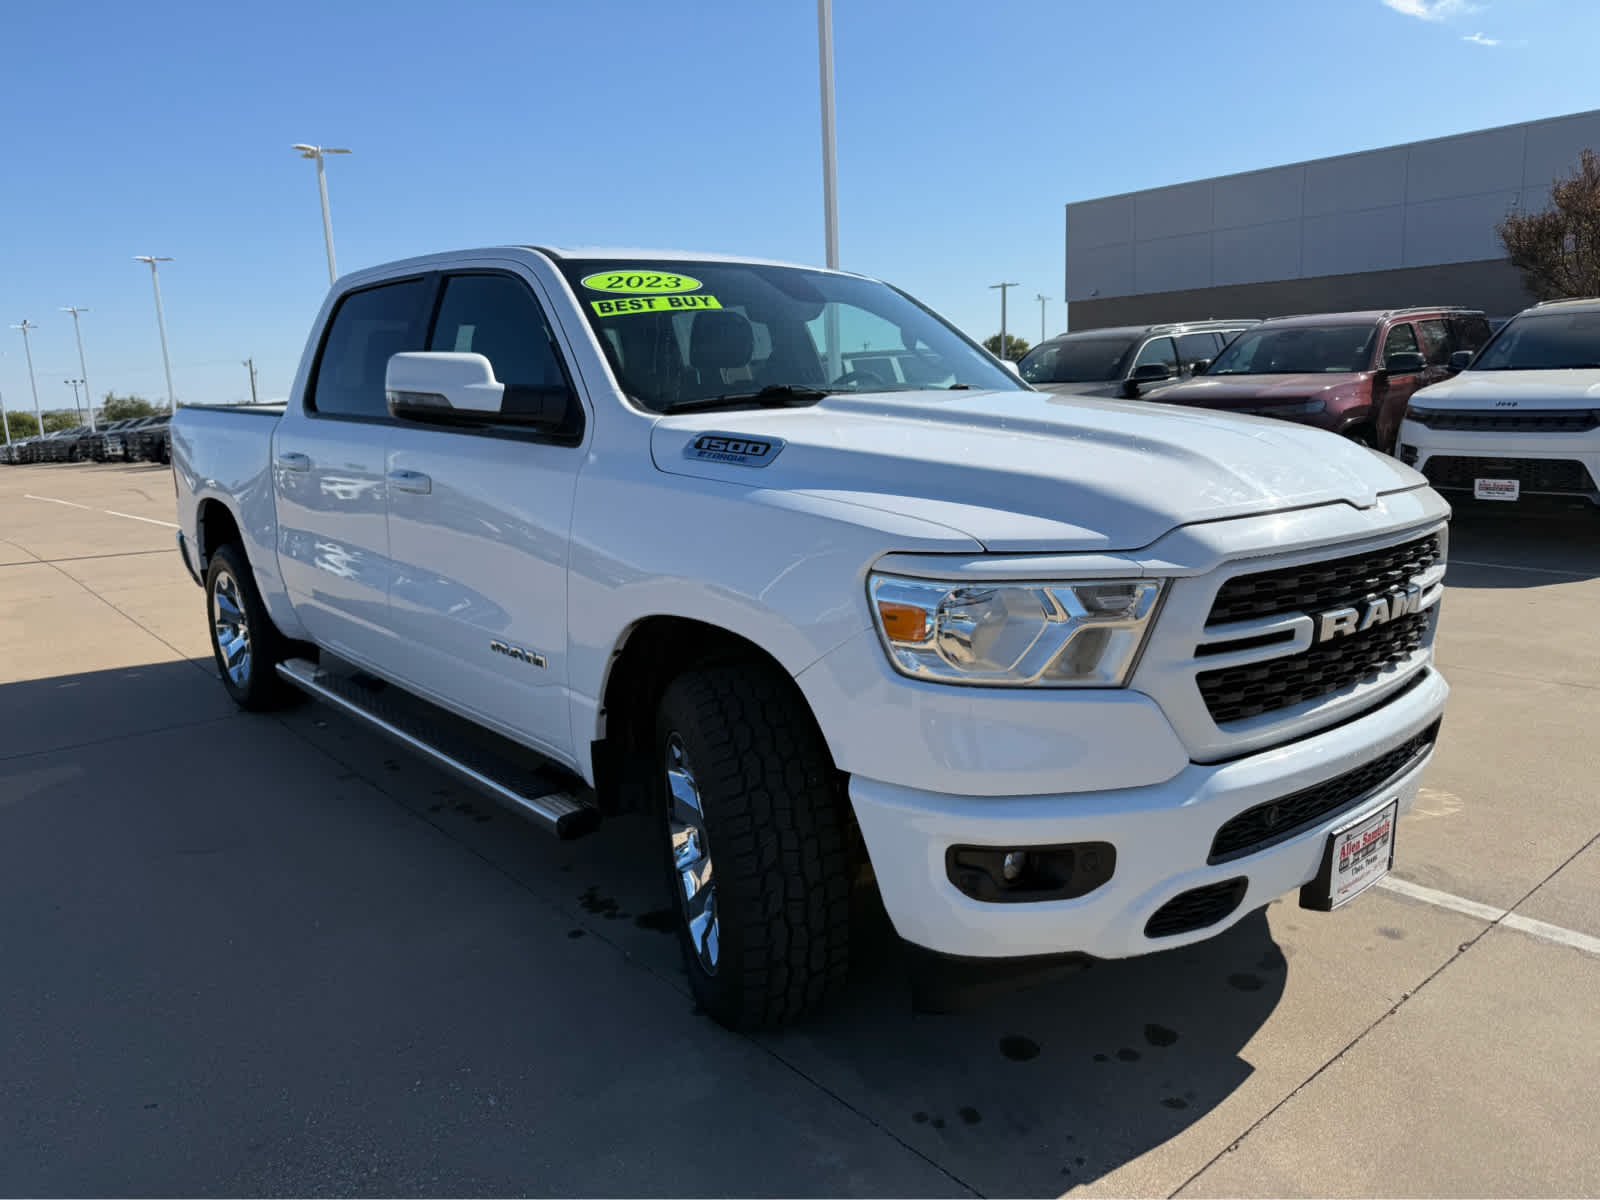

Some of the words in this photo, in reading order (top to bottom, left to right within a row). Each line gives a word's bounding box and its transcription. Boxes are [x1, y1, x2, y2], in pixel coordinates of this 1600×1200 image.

[606, 275, 681, 288] 2023
[597, 298, 656, 314] BEST
[667, 297, 711, 308] BUY
[701, 439, 767, 456] 1500
[1319, 585, 1420, 642] RAM
[1341, 840, 1361, 858] Allen
